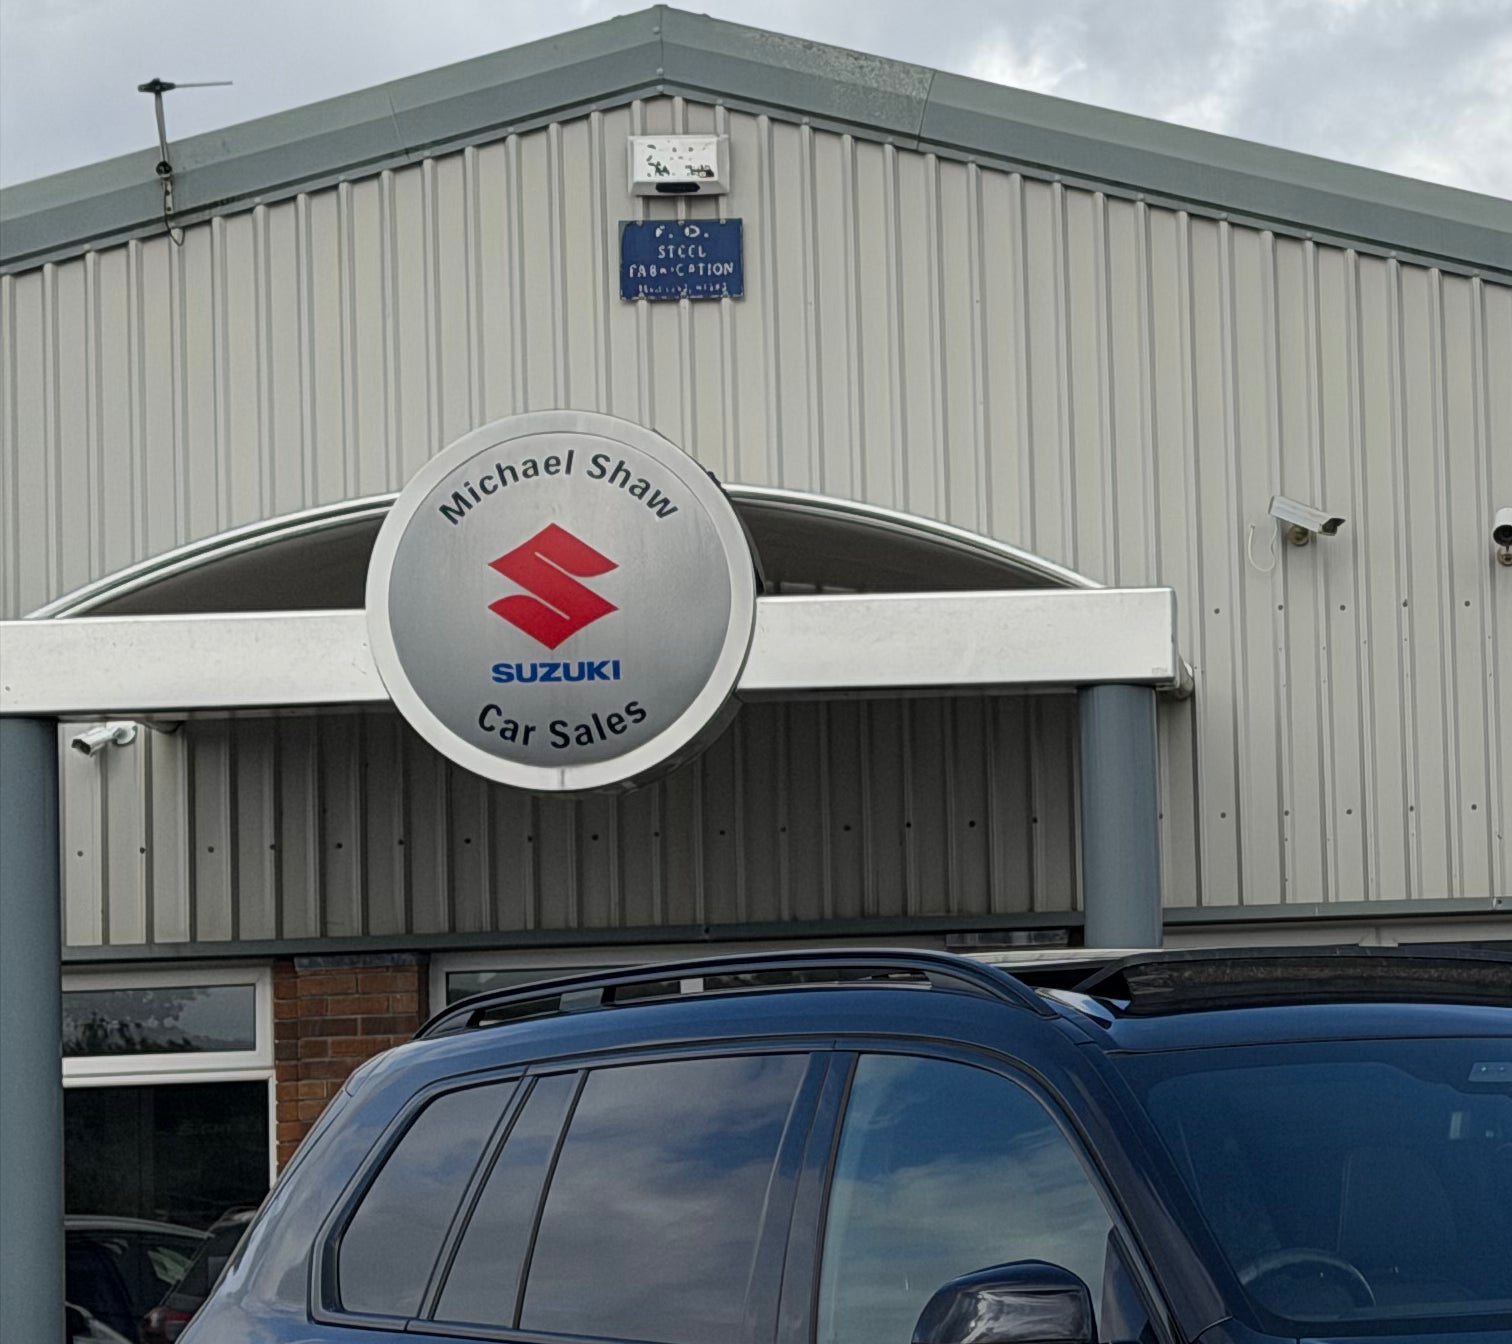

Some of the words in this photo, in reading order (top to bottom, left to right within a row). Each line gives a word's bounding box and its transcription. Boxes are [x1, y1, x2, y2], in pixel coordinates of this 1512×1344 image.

[438, 449, 575, 525] Michael
[586, 453, 679, 523] Shaw
[491, 659, 621, 683] SUZUKI
[478, 703, 536, 747] Car
[549, 700, 647, 749] Sales
